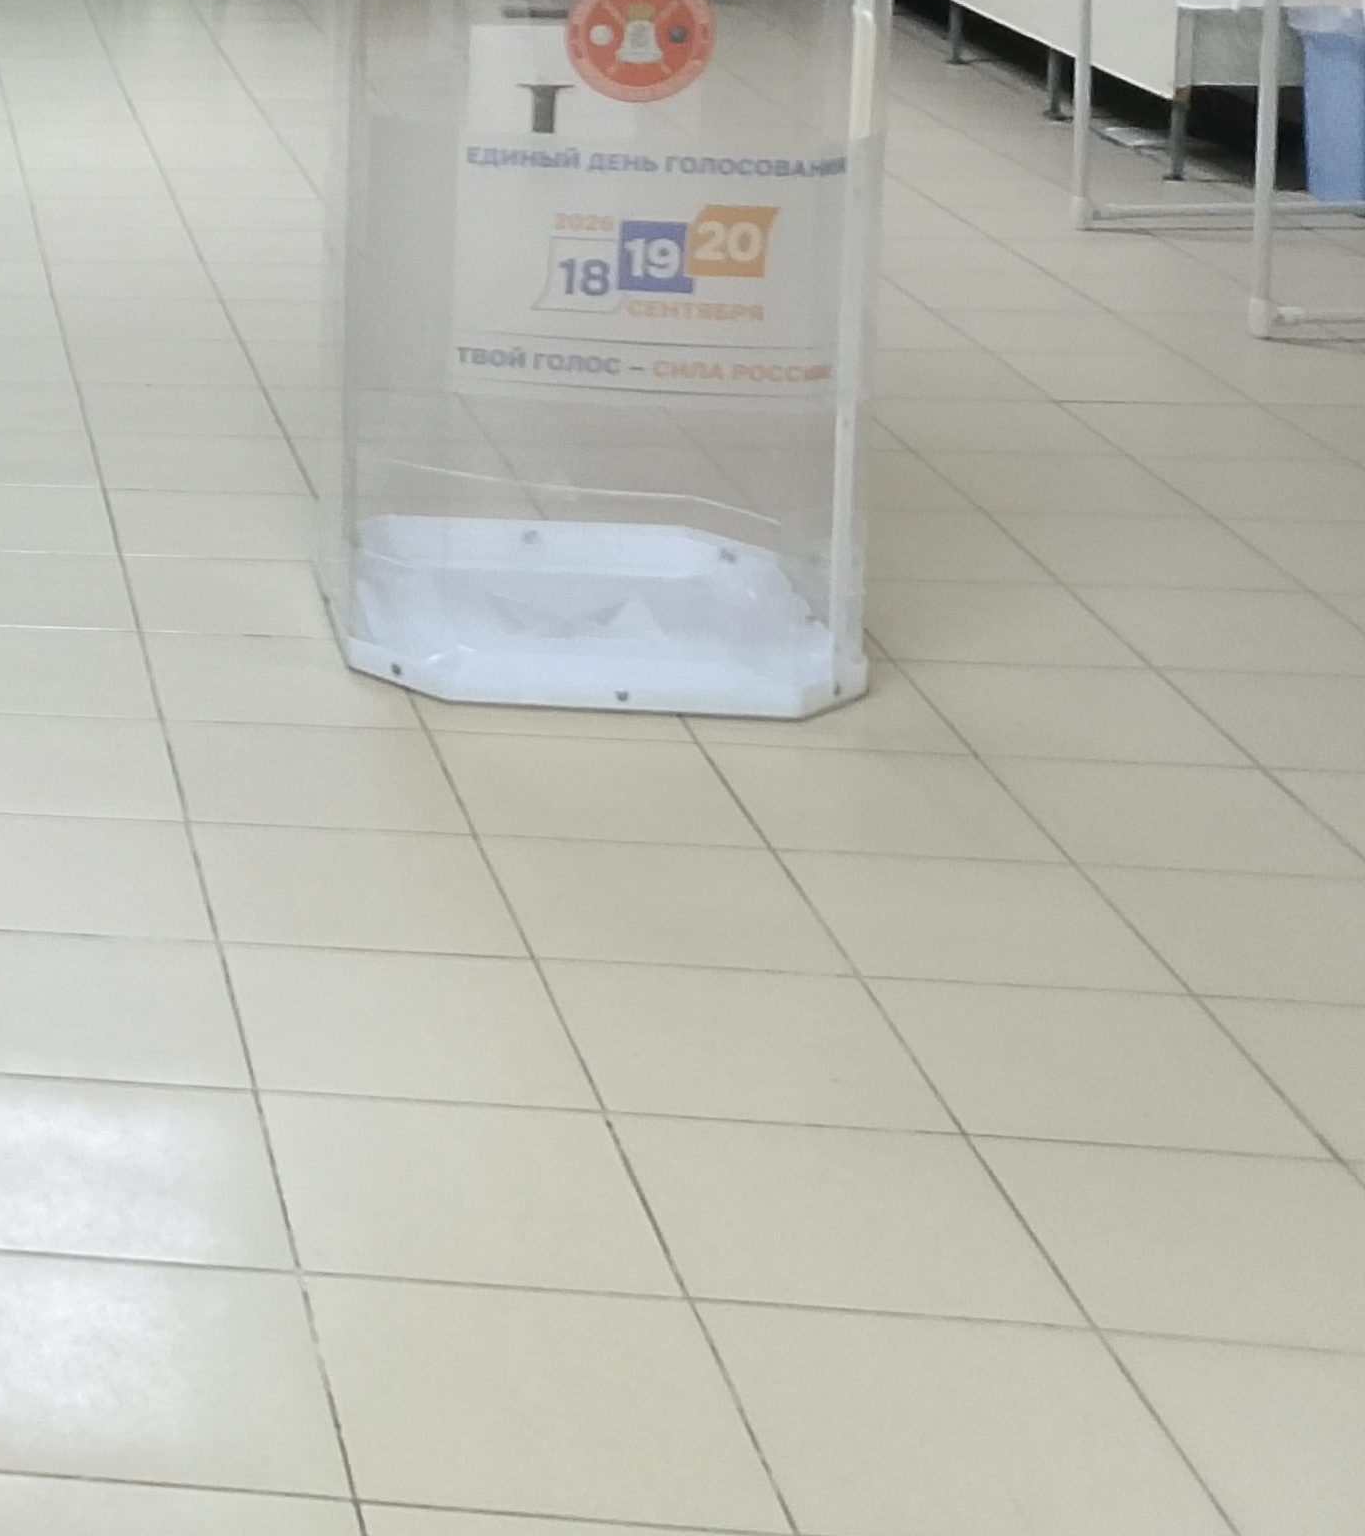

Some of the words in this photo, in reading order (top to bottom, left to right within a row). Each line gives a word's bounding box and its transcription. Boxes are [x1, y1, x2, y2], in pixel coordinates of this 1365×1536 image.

[467, 146, 581, 170] ЕДИНЫЙ
[586, 152, 660, 174] ДЕНЬ
[559, 258, 610, 296] 18
[624, 237, 682, 279] 19
[695, 220, 763, 262] 20
[625, 299, 765, 322] СЕНТЯБРЯ
[457, 346, 527, 370] ТВОЙ
[533, 352, 622, 375] ГОЛОС
[652, 360, 725, 381] СИЛА
